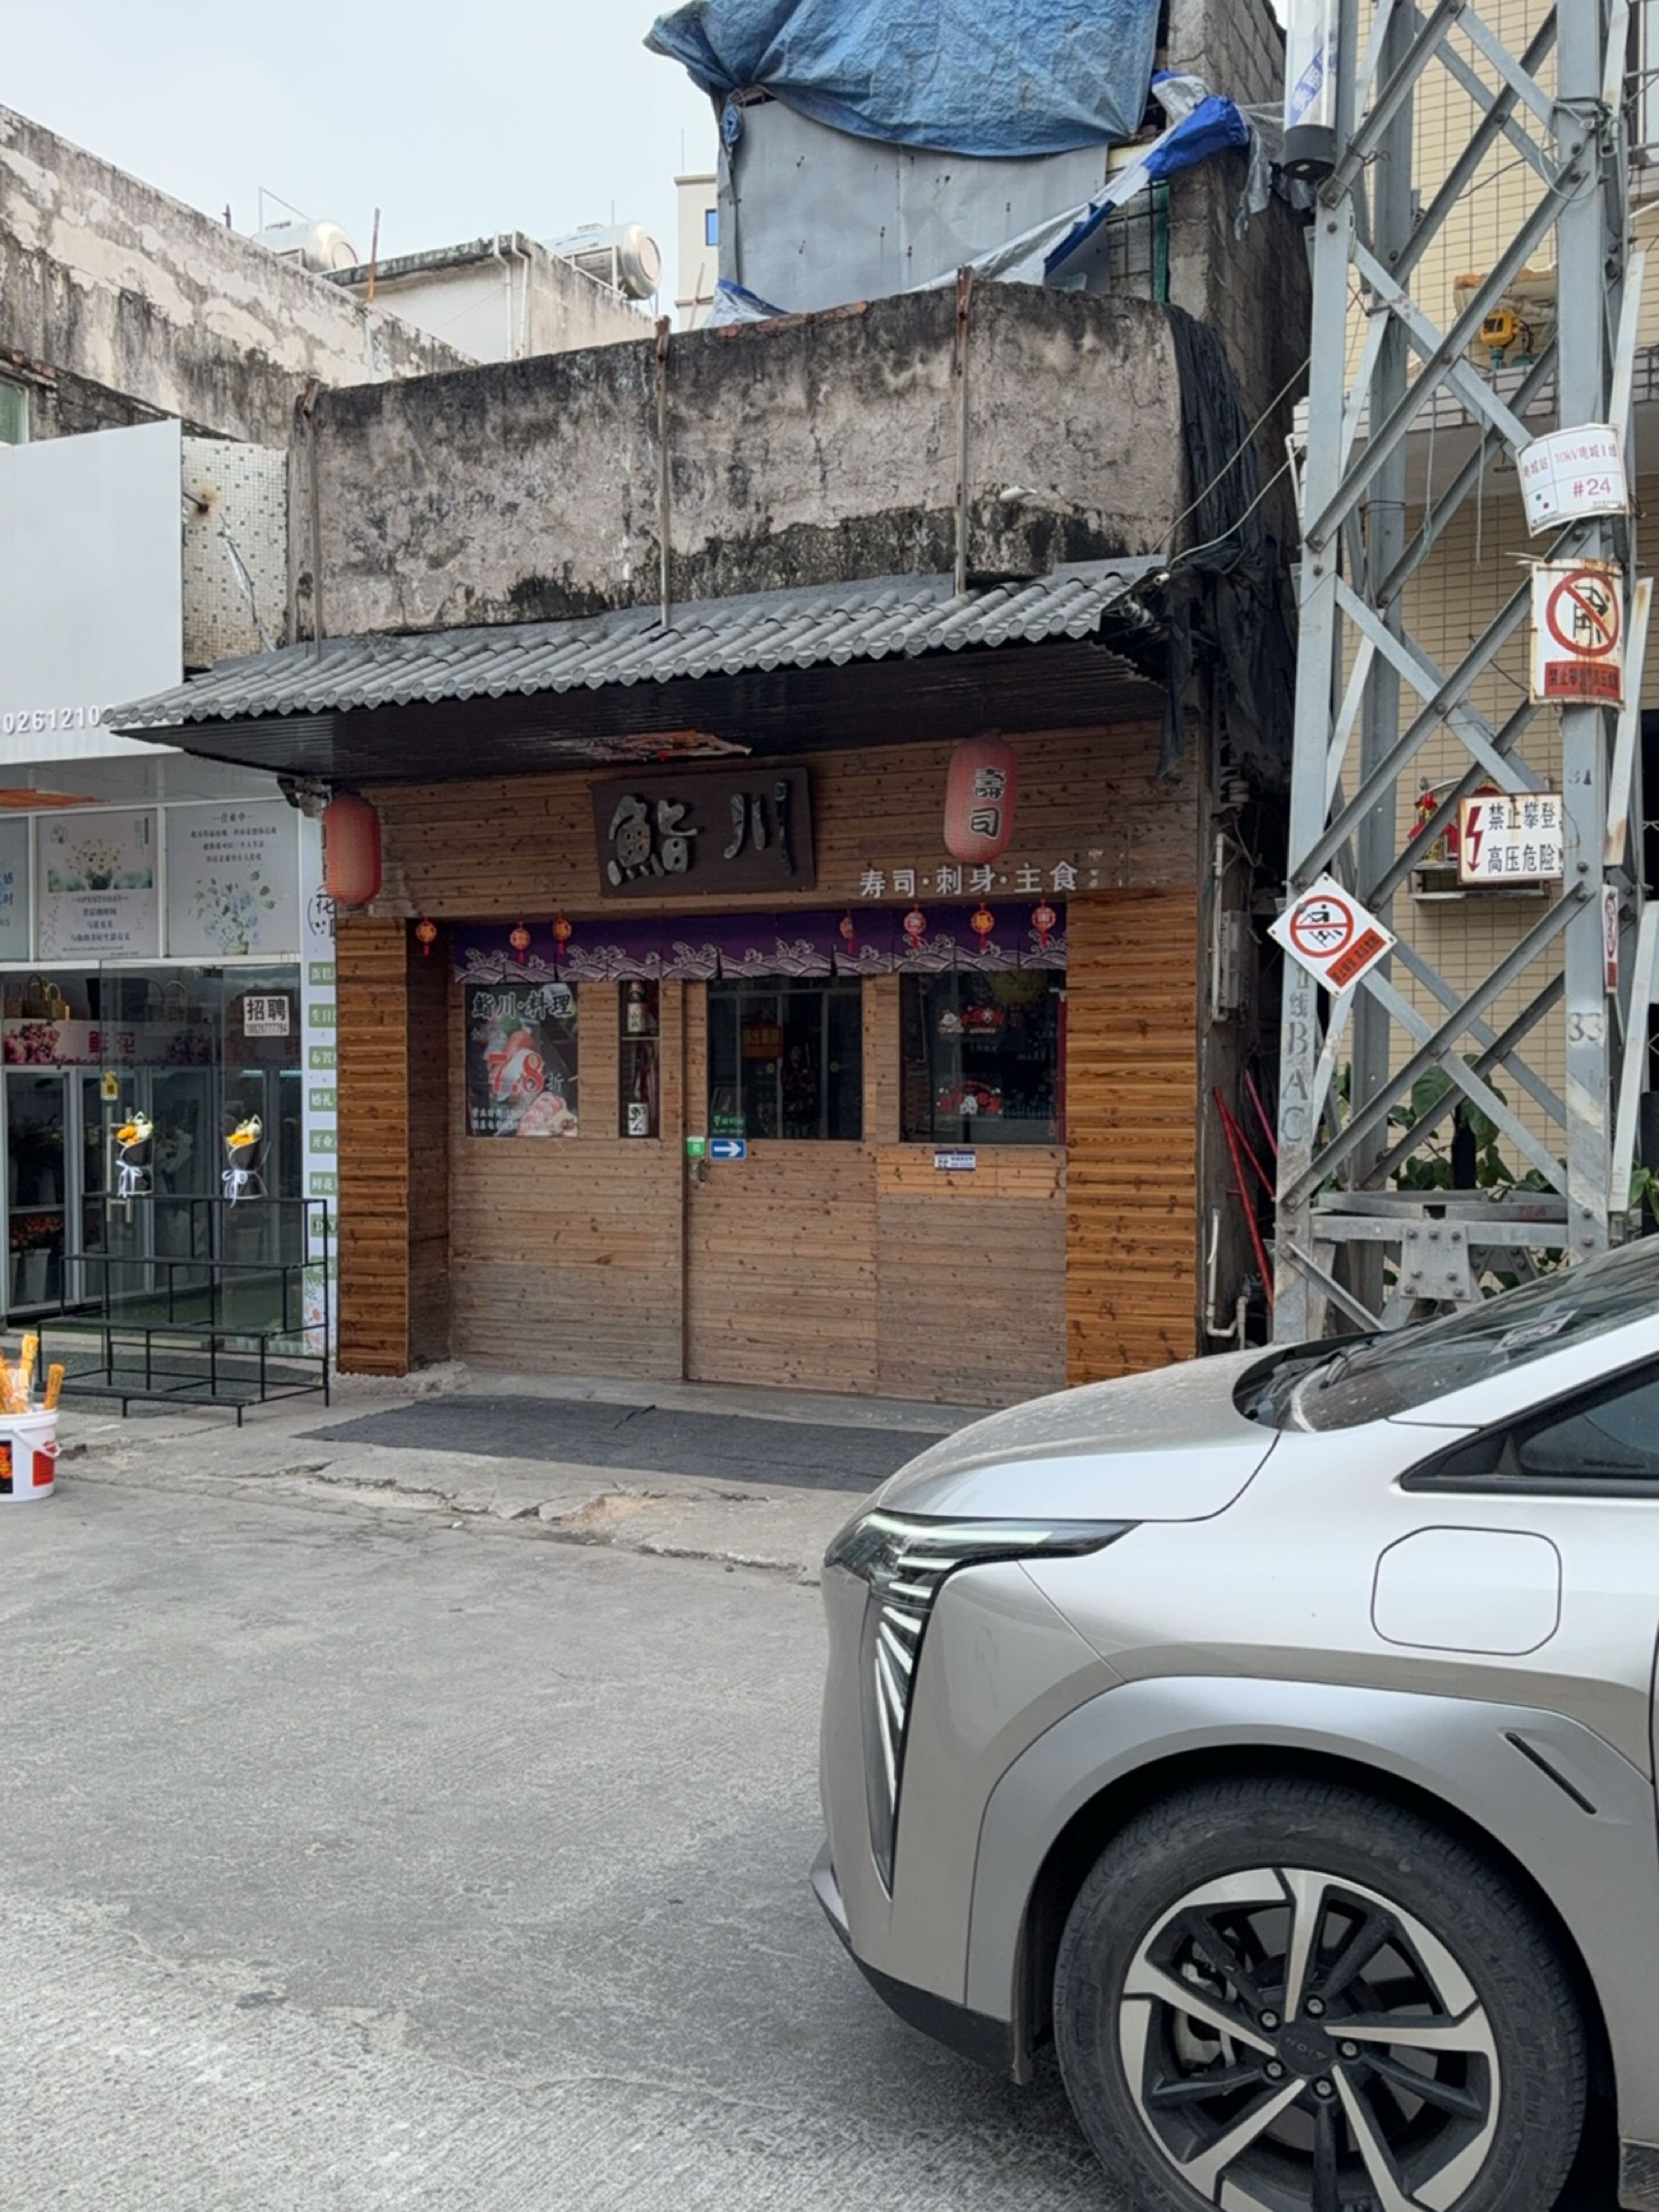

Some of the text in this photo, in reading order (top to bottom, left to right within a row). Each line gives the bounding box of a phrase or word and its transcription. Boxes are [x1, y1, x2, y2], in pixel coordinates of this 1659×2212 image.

[1572, 477, 1612, 498] #24
[1, 705, 111, 735] 0261210
[247, 998, 287, 1021] 招聘
[312, 1009, 336, 1023] 生日
[312, 1176, 337, 1191] 鲜花
